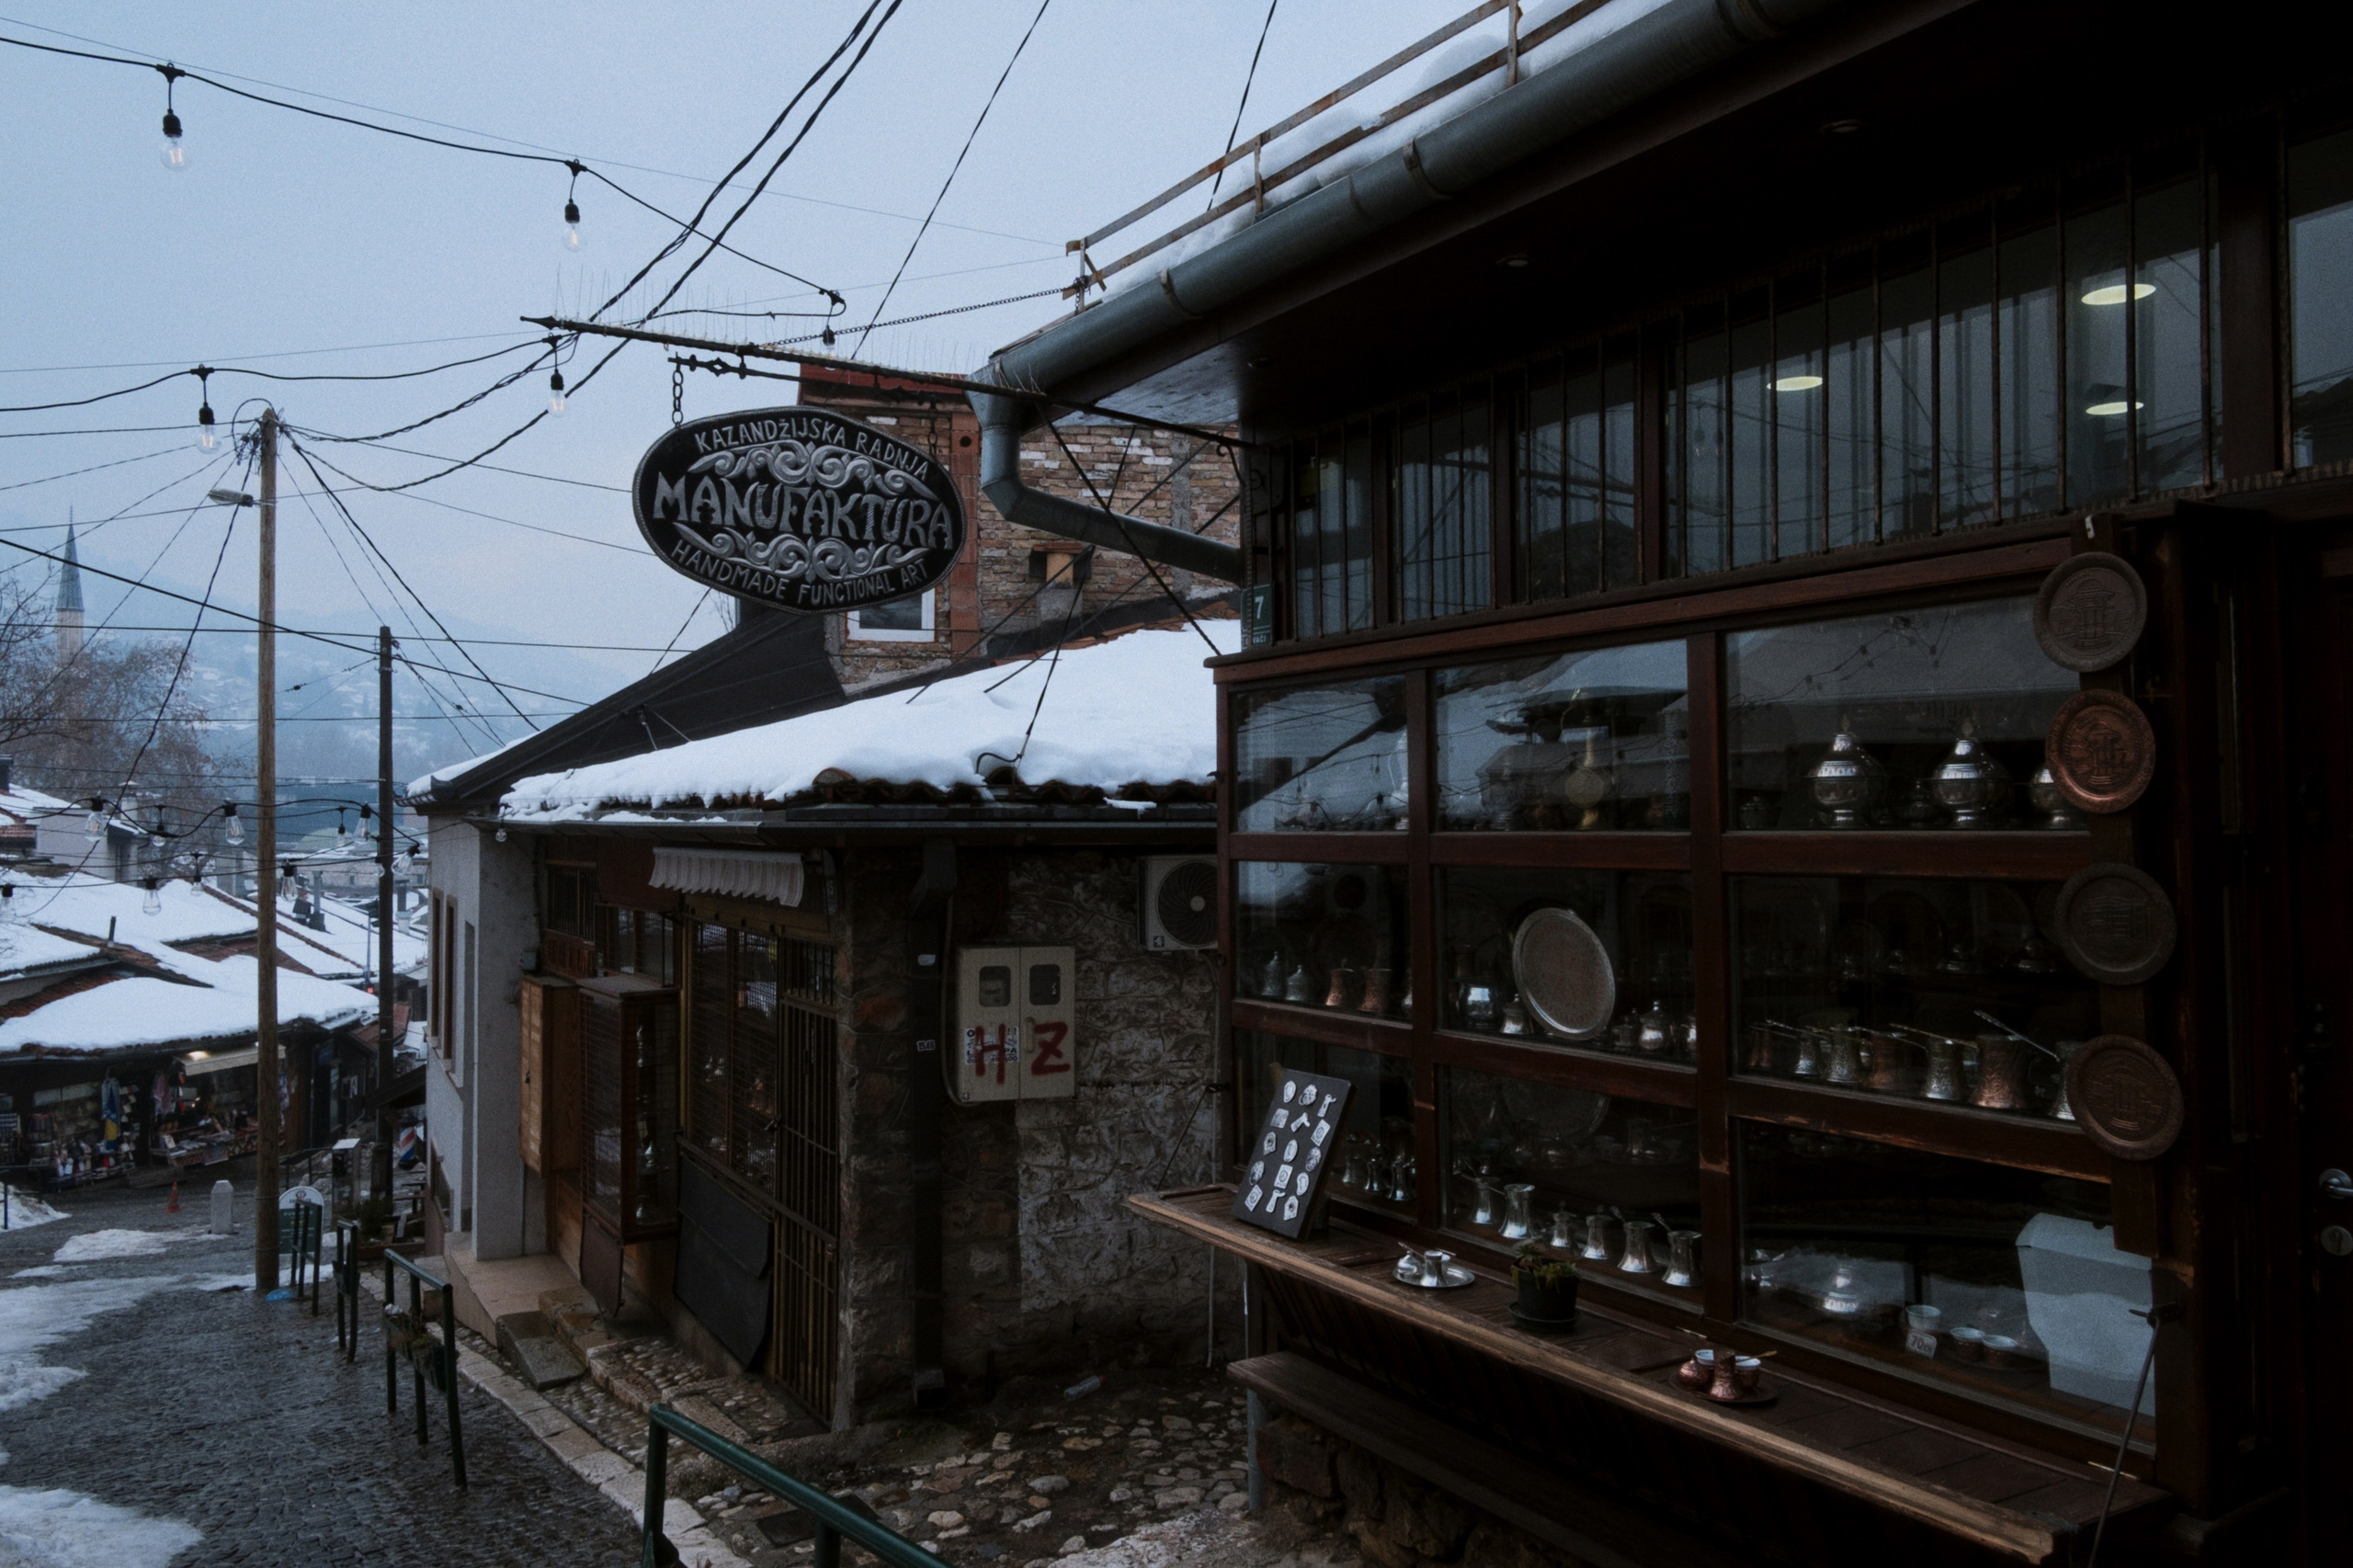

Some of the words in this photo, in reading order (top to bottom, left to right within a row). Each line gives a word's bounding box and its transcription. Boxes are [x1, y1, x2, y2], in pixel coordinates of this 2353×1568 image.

[694, 417, 846, 453] KAZANDŽIJSKA
[855, 431, 930, 481] RADNJA
[653, 471, 953, 550] MANUFAKTURA
[671, 539, 790, 599] HANDMADE
[797, 573, 896, 607] FUNCTIONAL
[900, 558, 928, 590] ART
[1254, 595, 1265, 620] 7
[975, 1023, 1006, 1085] H
[1031, 1021, 1072, 1076] Z
